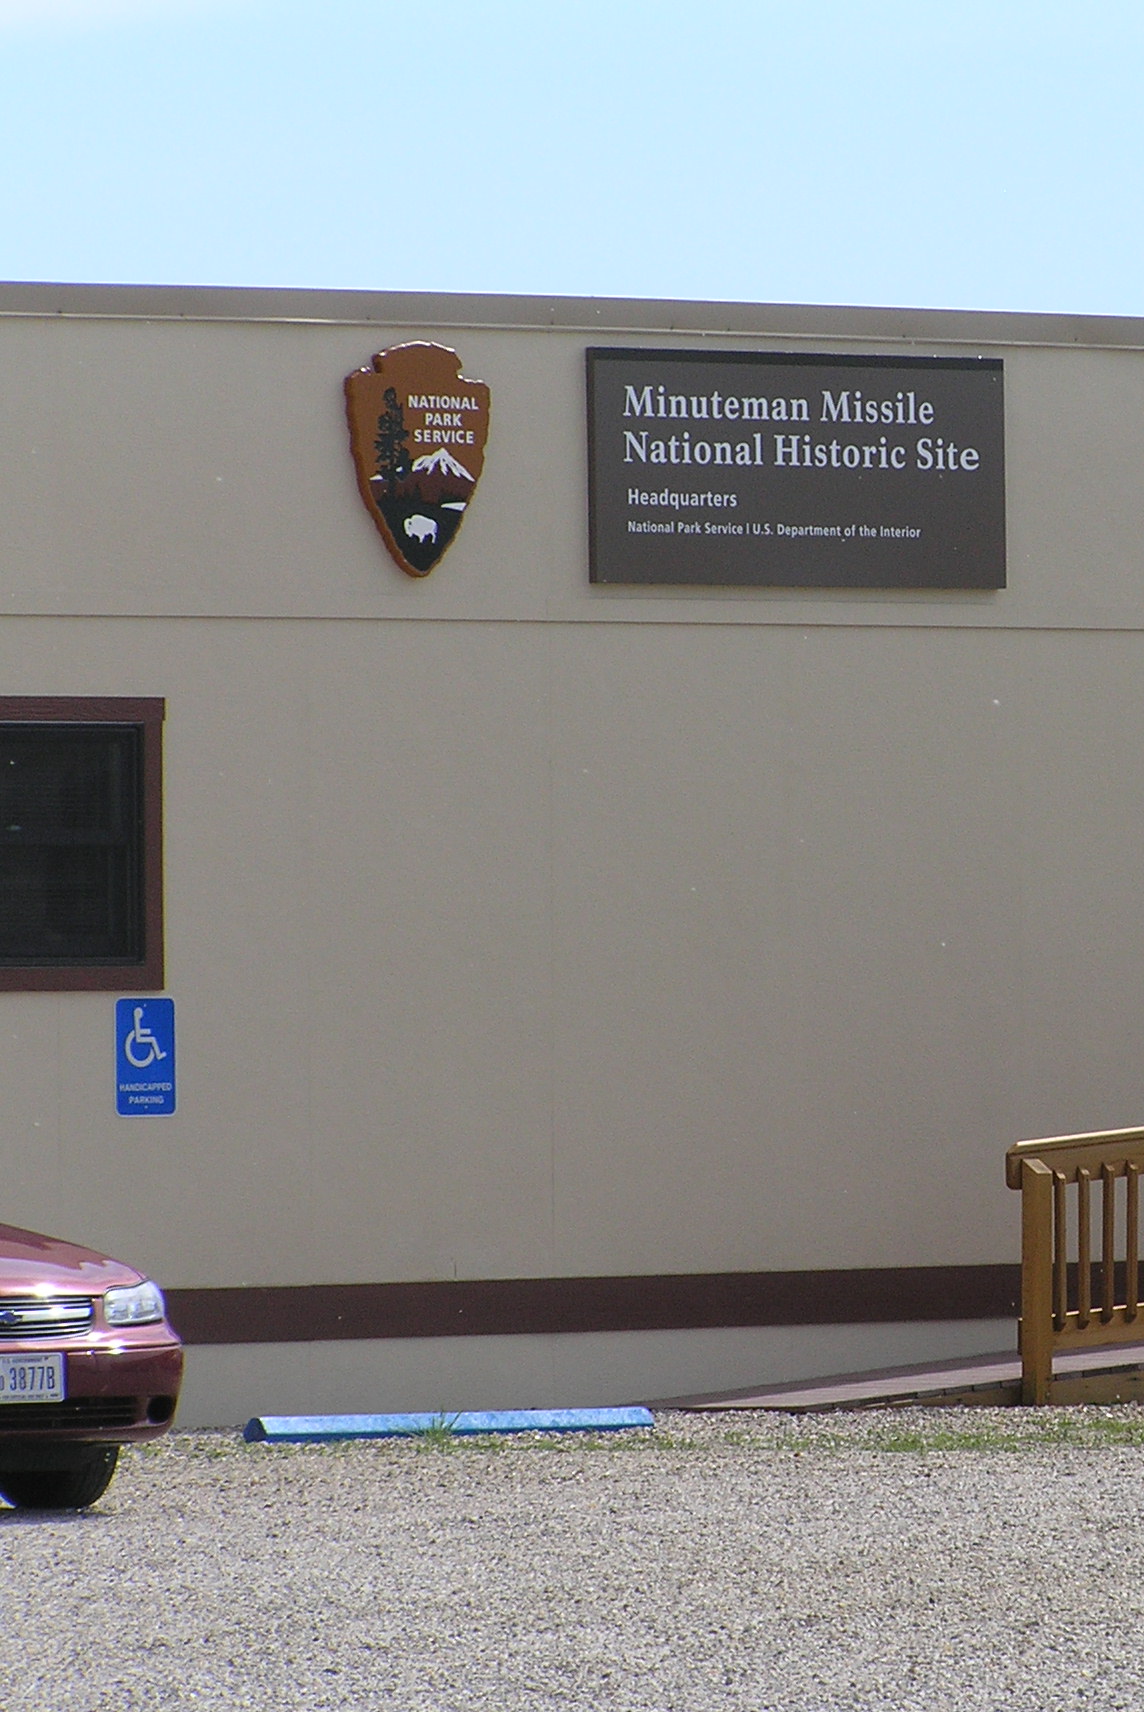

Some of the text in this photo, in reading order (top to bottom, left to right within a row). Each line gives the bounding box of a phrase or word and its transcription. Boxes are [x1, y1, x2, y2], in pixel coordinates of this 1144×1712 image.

[408, 395, 479, 410] NATIONAL
[622, 385, 935, 425] Minuteman Missile
[425, 412, 463, 427] PARK
[413, 428, 475, 444] SERVICE
[623, 431, 980, 472] National Historic Site
[628, 488, 738, 510] Headquarters
[627, 520, 674, 534] National
[677, 521, 702, 534] Park
[704, 522, 743, 535] Service
[752, 523, 774, 536] U.S.
[776, 523, 842, 539] Department
[843, 524, 856, 538] of
[858, 525, 877, 538] the
[879, 525, 922, 539] Interior
[120, 1082, 172, 1092] HANDICAPPED
[128, 1095, 164, 1104] PARKING
[9, 1366, 55, 1391] 3877B
